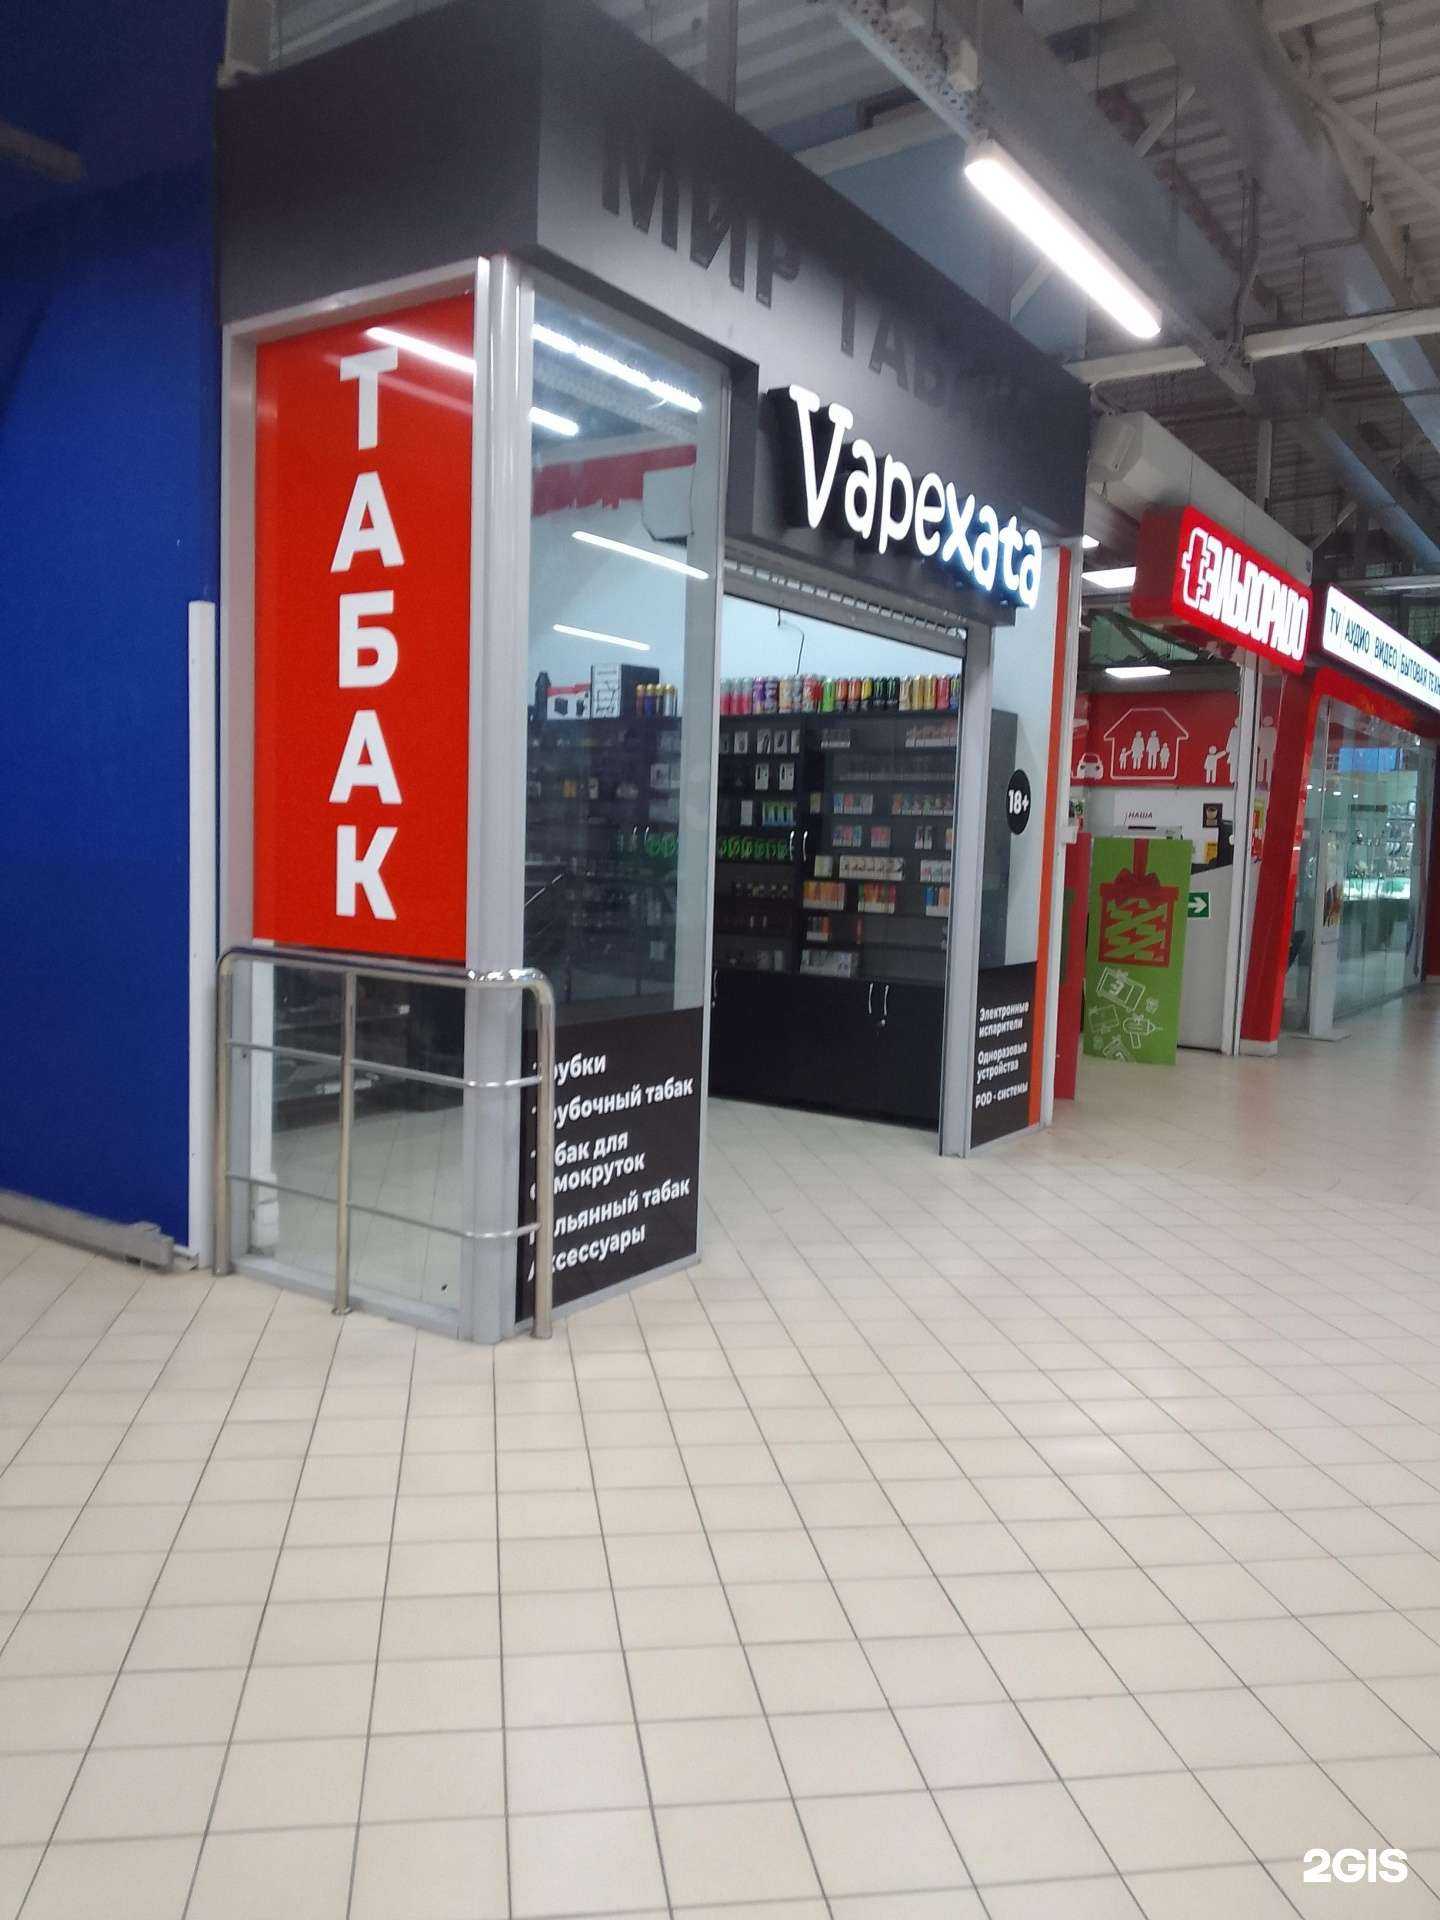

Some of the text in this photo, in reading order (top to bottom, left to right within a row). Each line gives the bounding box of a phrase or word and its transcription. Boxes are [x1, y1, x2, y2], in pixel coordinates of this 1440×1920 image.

[601, 135, 801, 310] МИР
[789, 384, 1042, 609] Vapexata
[329, 345, 405, 920] ТАБАК
[1330, 607, 1341, 636] TV
[1345, 618, 1370, 654] АУДИО
[1374, 636, 1398, 670] ВИДЕО
[1400, 653, 1428, 684] БЫТОВАЯ
[1008, 789, 1029, 814] 18+
[979, 1001, 1029, 1021] Электронные
[979, 1018, 1023, 1038] испарители
[532, 1053, 607, 1086] убки
[978, 1042, 1028, 1065] Одноразовые
[977, 1059, 1019, 1084] устройства
[531, 1076, 694, 1129] убочный табак
[975, 1091, 992, 1109] POD
[997, 1081, 1028, 1101] системы
[530, 1131, 629, 1168] бак для
[529, 1176, 692, 1245] льянный табак
